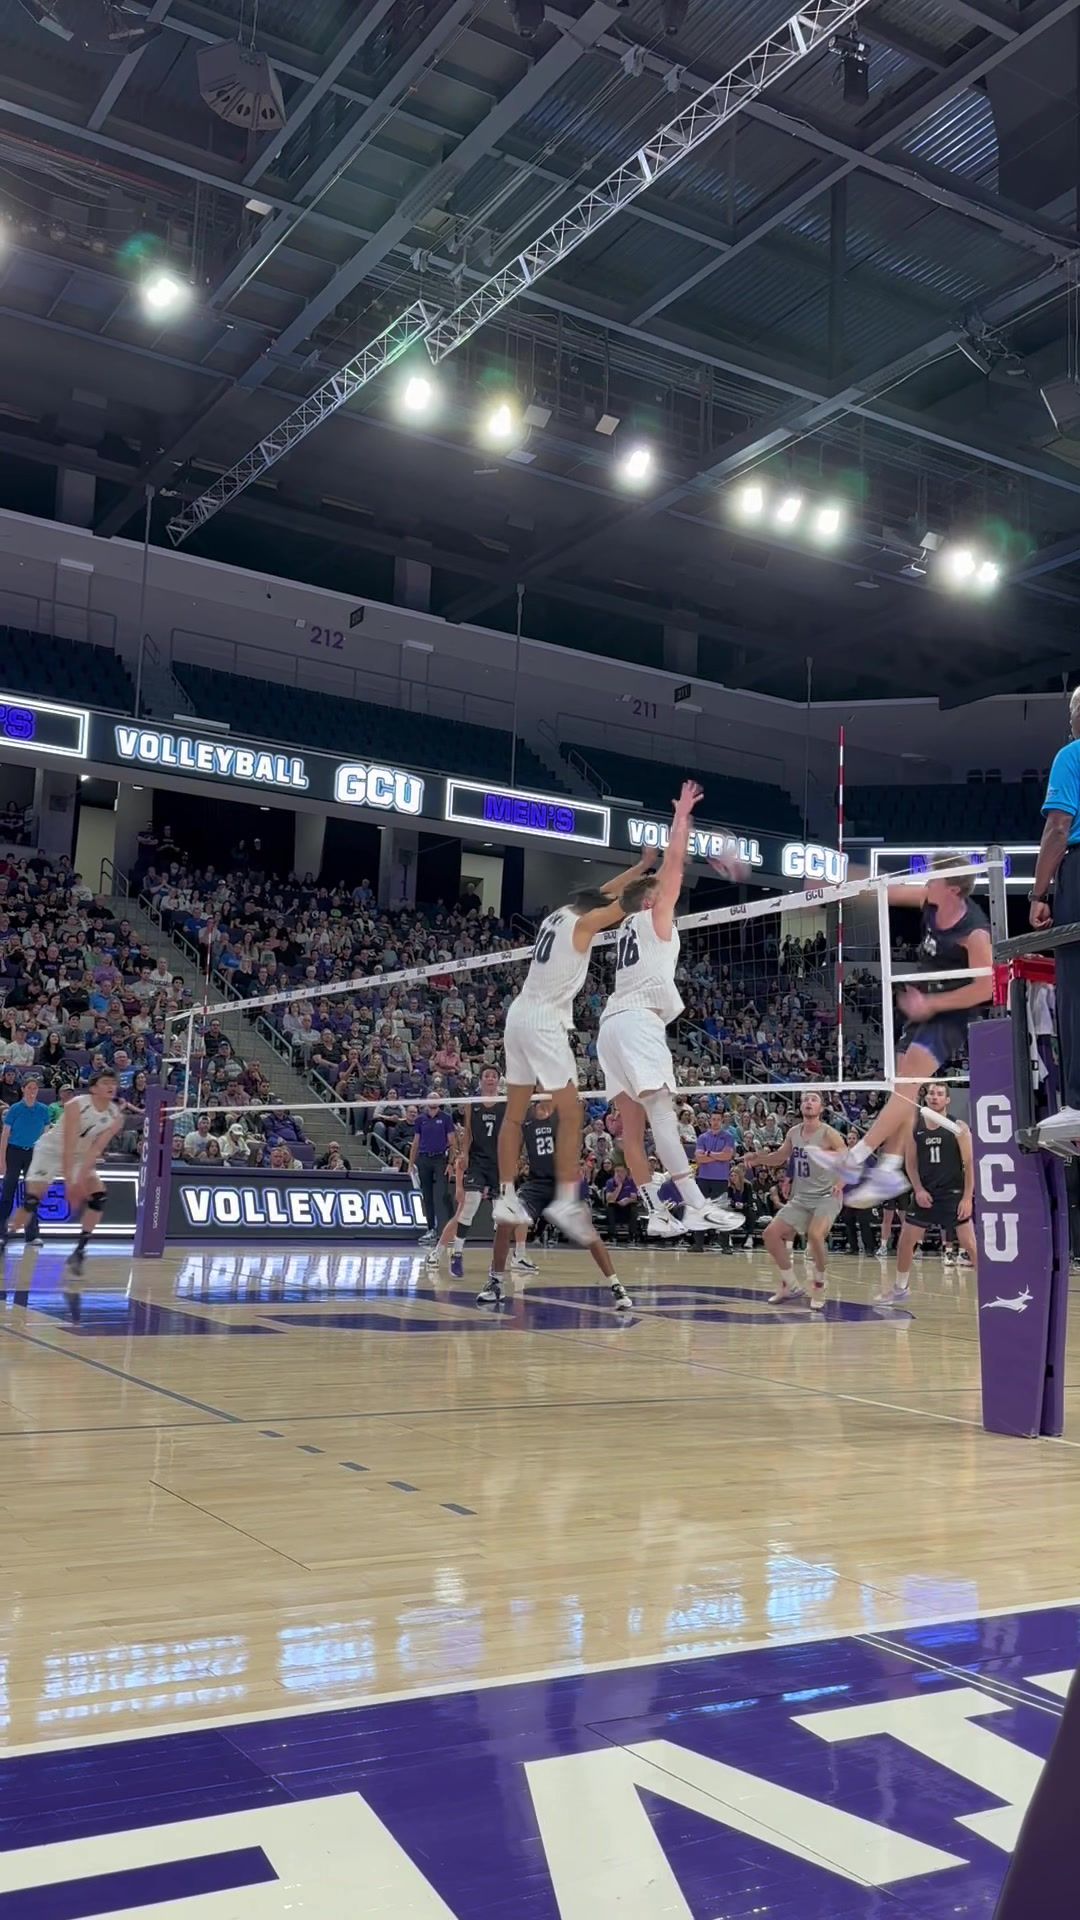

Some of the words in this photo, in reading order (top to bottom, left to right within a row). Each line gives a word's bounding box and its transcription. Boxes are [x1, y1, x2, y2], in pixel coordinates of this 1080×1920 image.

[310, 626, 344, 649] 212
[633, 699, 656, 719] 211
[114, 725, 309, 789] VOLLEYBALL
[334, 763, 425, 816] GCU
[483, 793, 575, 833] MEN'S
[628, 818, 763, 867] VOLEYBALL
[782, 843, 848, 884] GCU
[805, 889, 824, 901] GCU
[729, 905, 747, 916] GCU
[532, 927, 556, 964] 10
[617, 928, 640, 972] 16
[485, 1121, 494, 1137] 7
[925, 1136, 942, 1145] GCU
[536, 1136, 555, 1156] 23
[929, 1146, 941, 1164] 11
[797, 1161, 811, 1178] 13
[976, 1094, 1021, 1262] GCU
[181, 1186, 429, 1228] VOLLEYBALL
